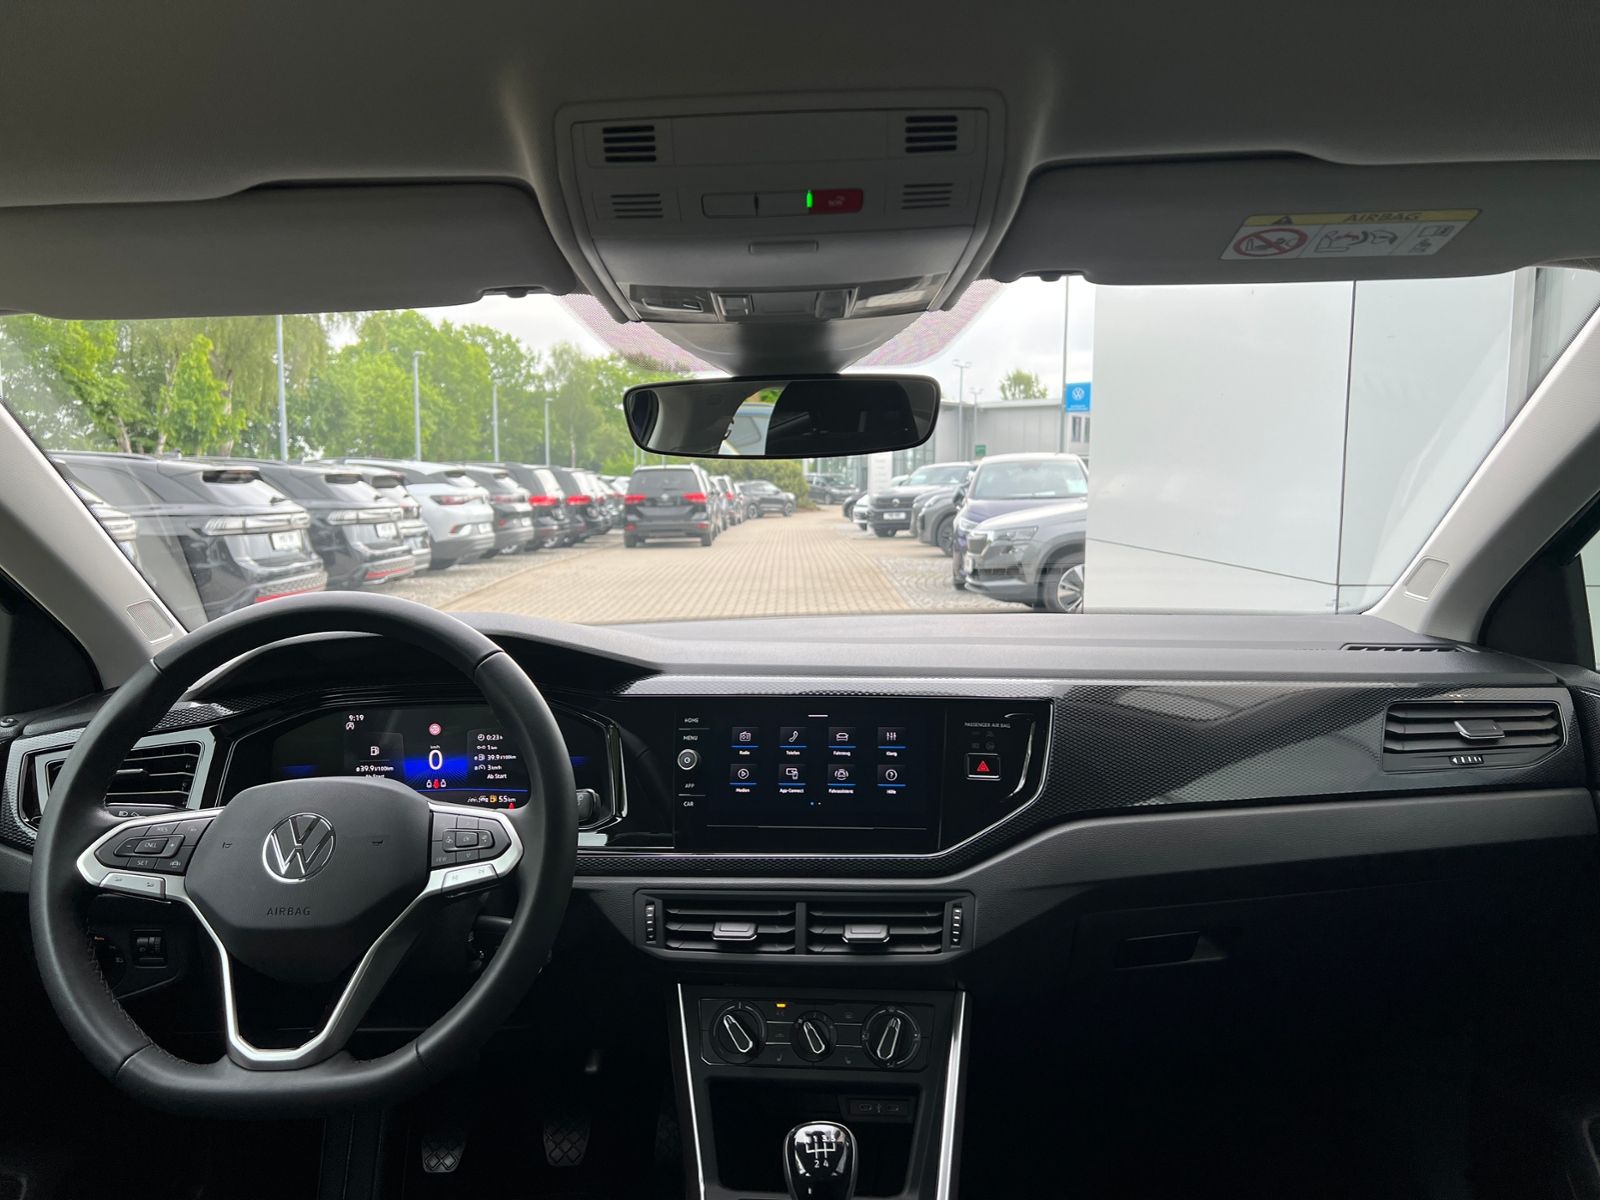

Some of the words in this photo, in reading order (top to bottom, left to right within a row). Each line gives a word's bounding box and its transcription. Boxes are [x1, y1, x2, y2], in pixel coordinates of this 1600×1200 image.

[1342, 212, 1422, 223] AIRBAG
[428, 749, 443, 770] 0
[267, 906, 311, 916] AIRBAG
[814, 1160, 820, 1168] 2
[823, 1160, 829, 1168] 4
